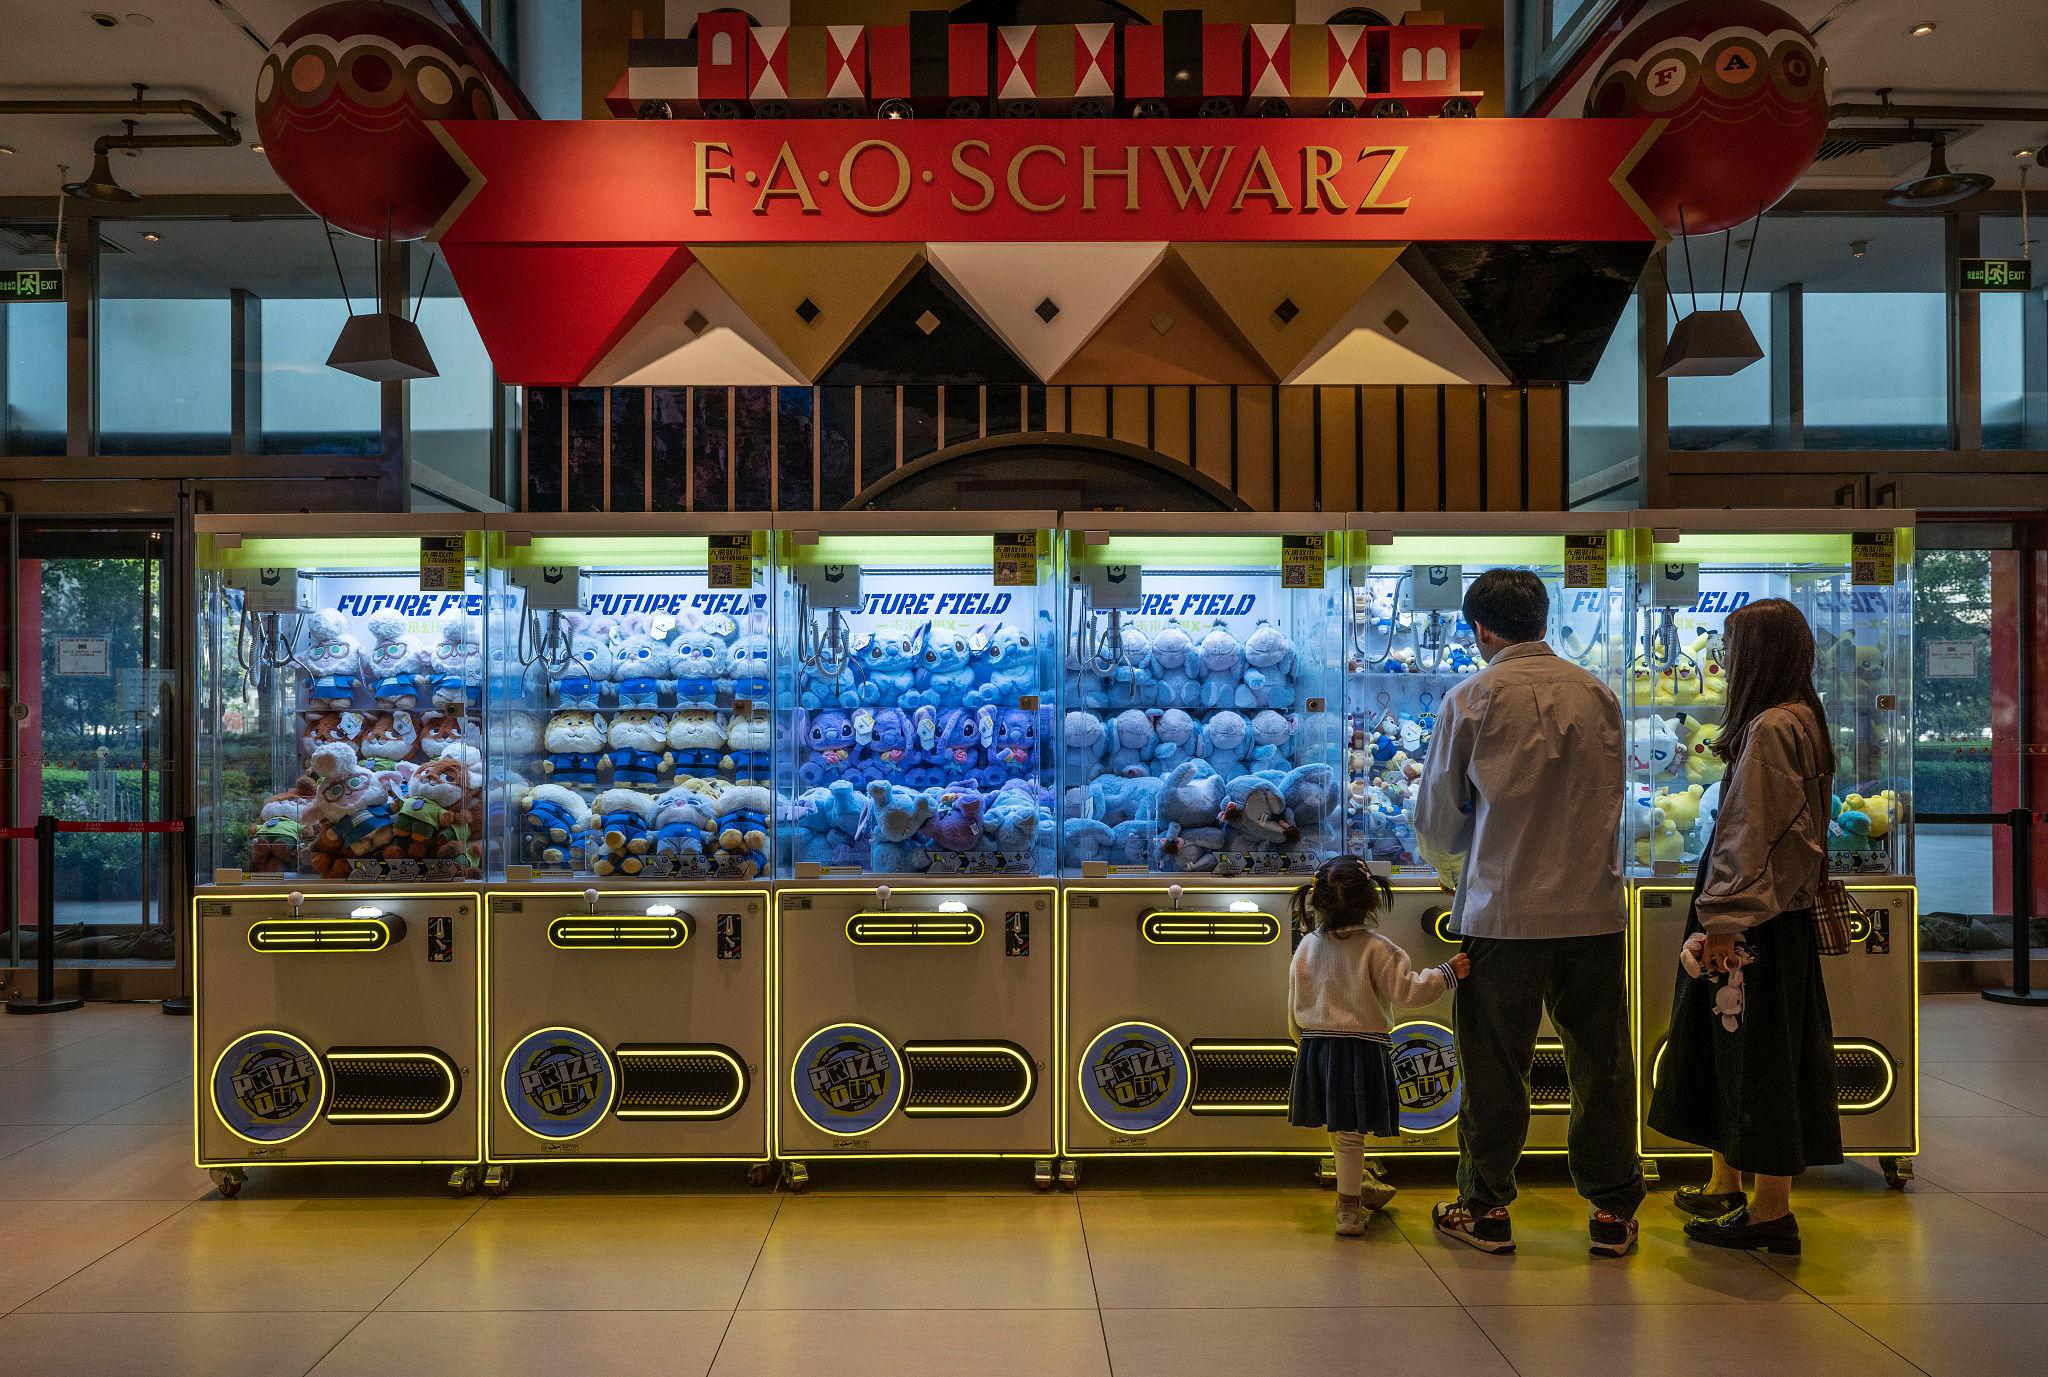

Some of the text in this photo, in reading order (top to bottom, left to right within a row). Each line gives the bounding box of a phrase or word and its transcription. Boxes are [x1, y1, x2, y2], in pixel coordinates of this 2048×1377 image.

[1723, 54, 1749, 71] A
[40, 280, 58, 290] EXIT
[2008, 270, 2026, 280] EXIT
[446, 538, 462, 548] 03
[732, 536, 749, 545] 04
[1017, 533, 1034, 543] 05
[1305, 536, 1322, 546] 06
[1588, 536, 1605, 545] 07
[337, 594, 438, 617] FUTURE
[586, 593, 687, 616] FUTURE
[851, 593, 1012, 615] UTURE FIELD
[1180, 593, 1256, 616] FIELD
[1688, 591, 1750, 613] IELD
[519, 1050, 603, 1095] PRIZE
[807, 1047, 891, 1091] PRIZE
[1093, 1044, 1175, 1088] PRIZE
[1393, 1043, 1458, 1082] RIZE
[231, 1054, 315, 1099] PRIZE
[1115, 1071, 1168, 1104] OUT
[1397, 1070, 1452, 1105] OUT
[254, 1081, 308, 1115] OUT
[541, 1077, 596, 1112] OUT
[829, 1074, 883, 1107] OUT
